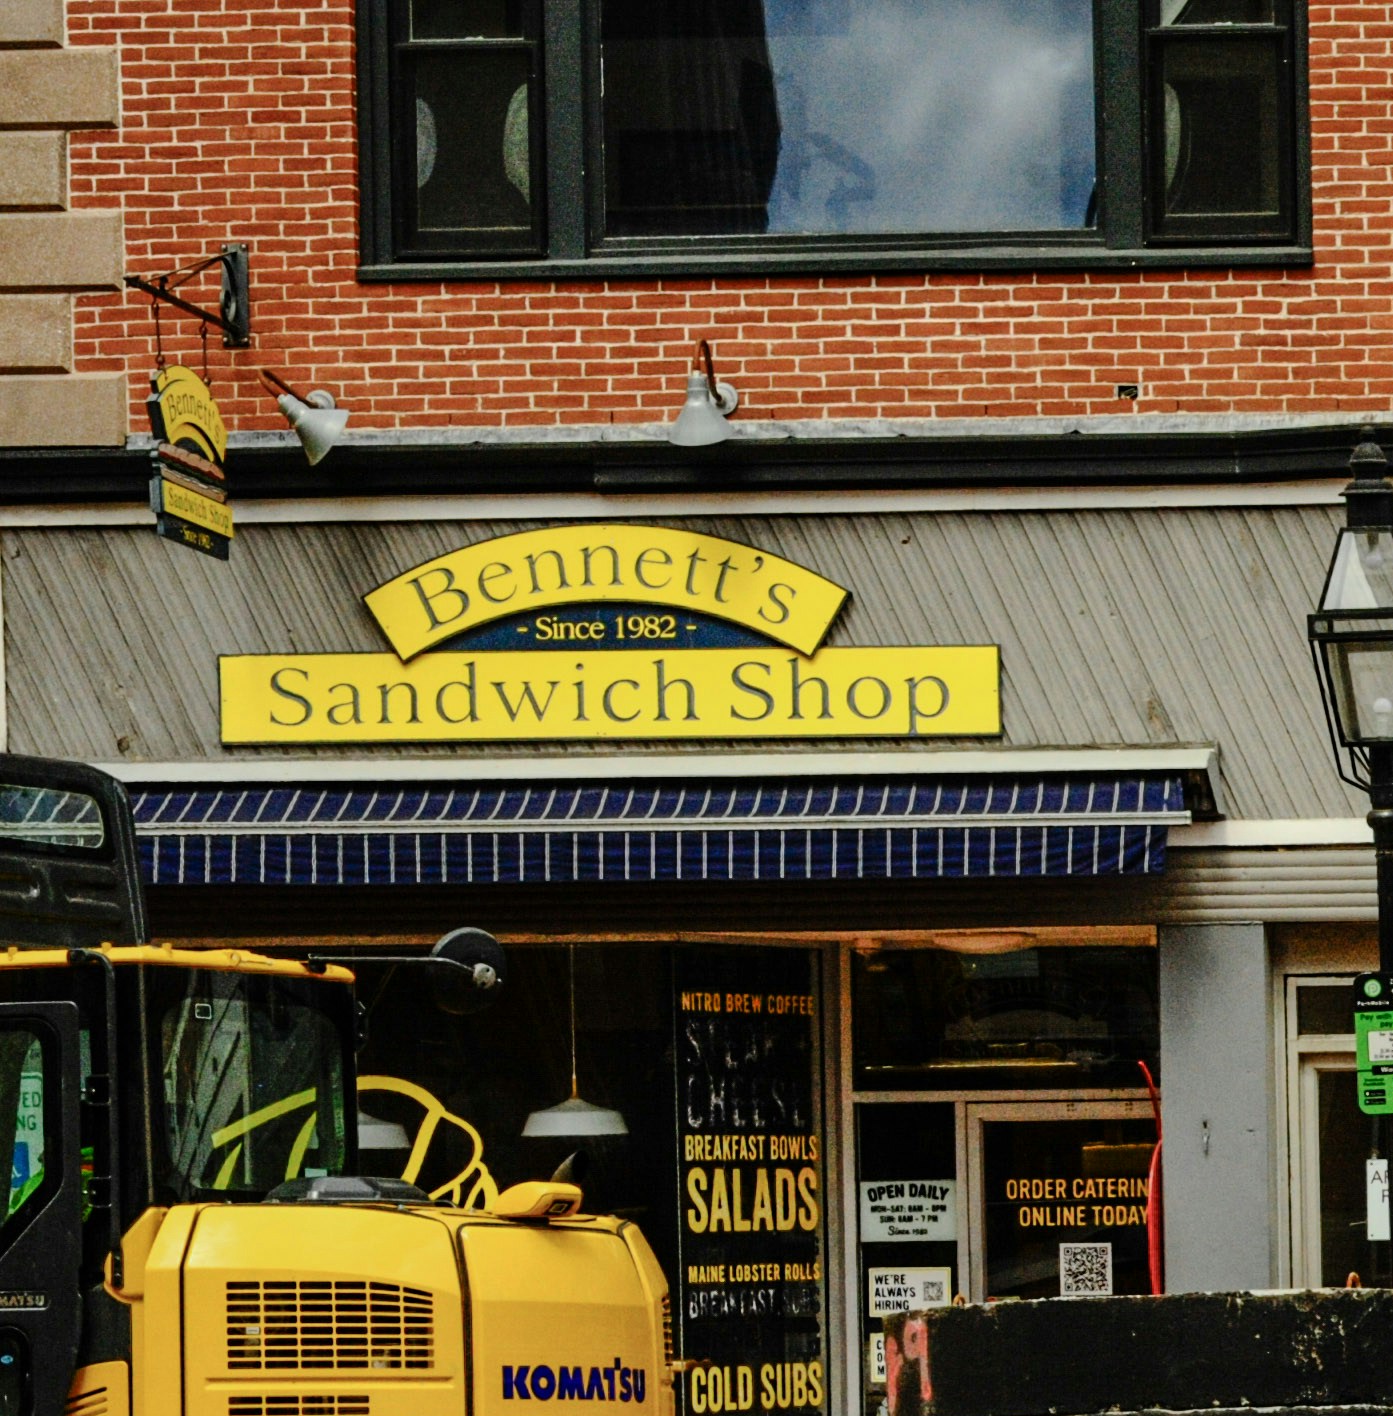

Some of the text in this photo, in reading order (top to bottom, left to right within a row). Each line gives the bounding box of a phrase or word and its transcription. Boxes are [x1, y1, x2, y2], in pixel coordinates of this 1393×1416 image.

[166, 392, 221, 444] Bennett's
[168, 487, 207, 519] Sandwich
[407, 543, 799, 634] Bennett's
[535, 616, 677, 641] Since 1982
[268, 658, 951, 736] Sandwich Shop
[682, 991, 816, 1016] NITRO BREW COFFEE
[684, 1134, 820, 1161] BREAKFAST BOWLS
[687, 1166, 819, 1234] SALADS
[867, 1183, 950, 1202] OPEN DAILY
[1006, 1177, 1149, 1200] ORDER CATERIN
[1019, 1205, 1149, 1227] ONLINE TODAY
[688, 1261, 821, 1284] MAINE LOBSTER ROLLS
[874, 1273, 907, 1285] WE'RE
[874, 1286, 917, 1298] ALWAYS
[874, 1299, 910, 1311] HIRING
[501, 1356, 646, 1404] KOMATSU
[691, 1360, 824, 1414] COLD SUBS
